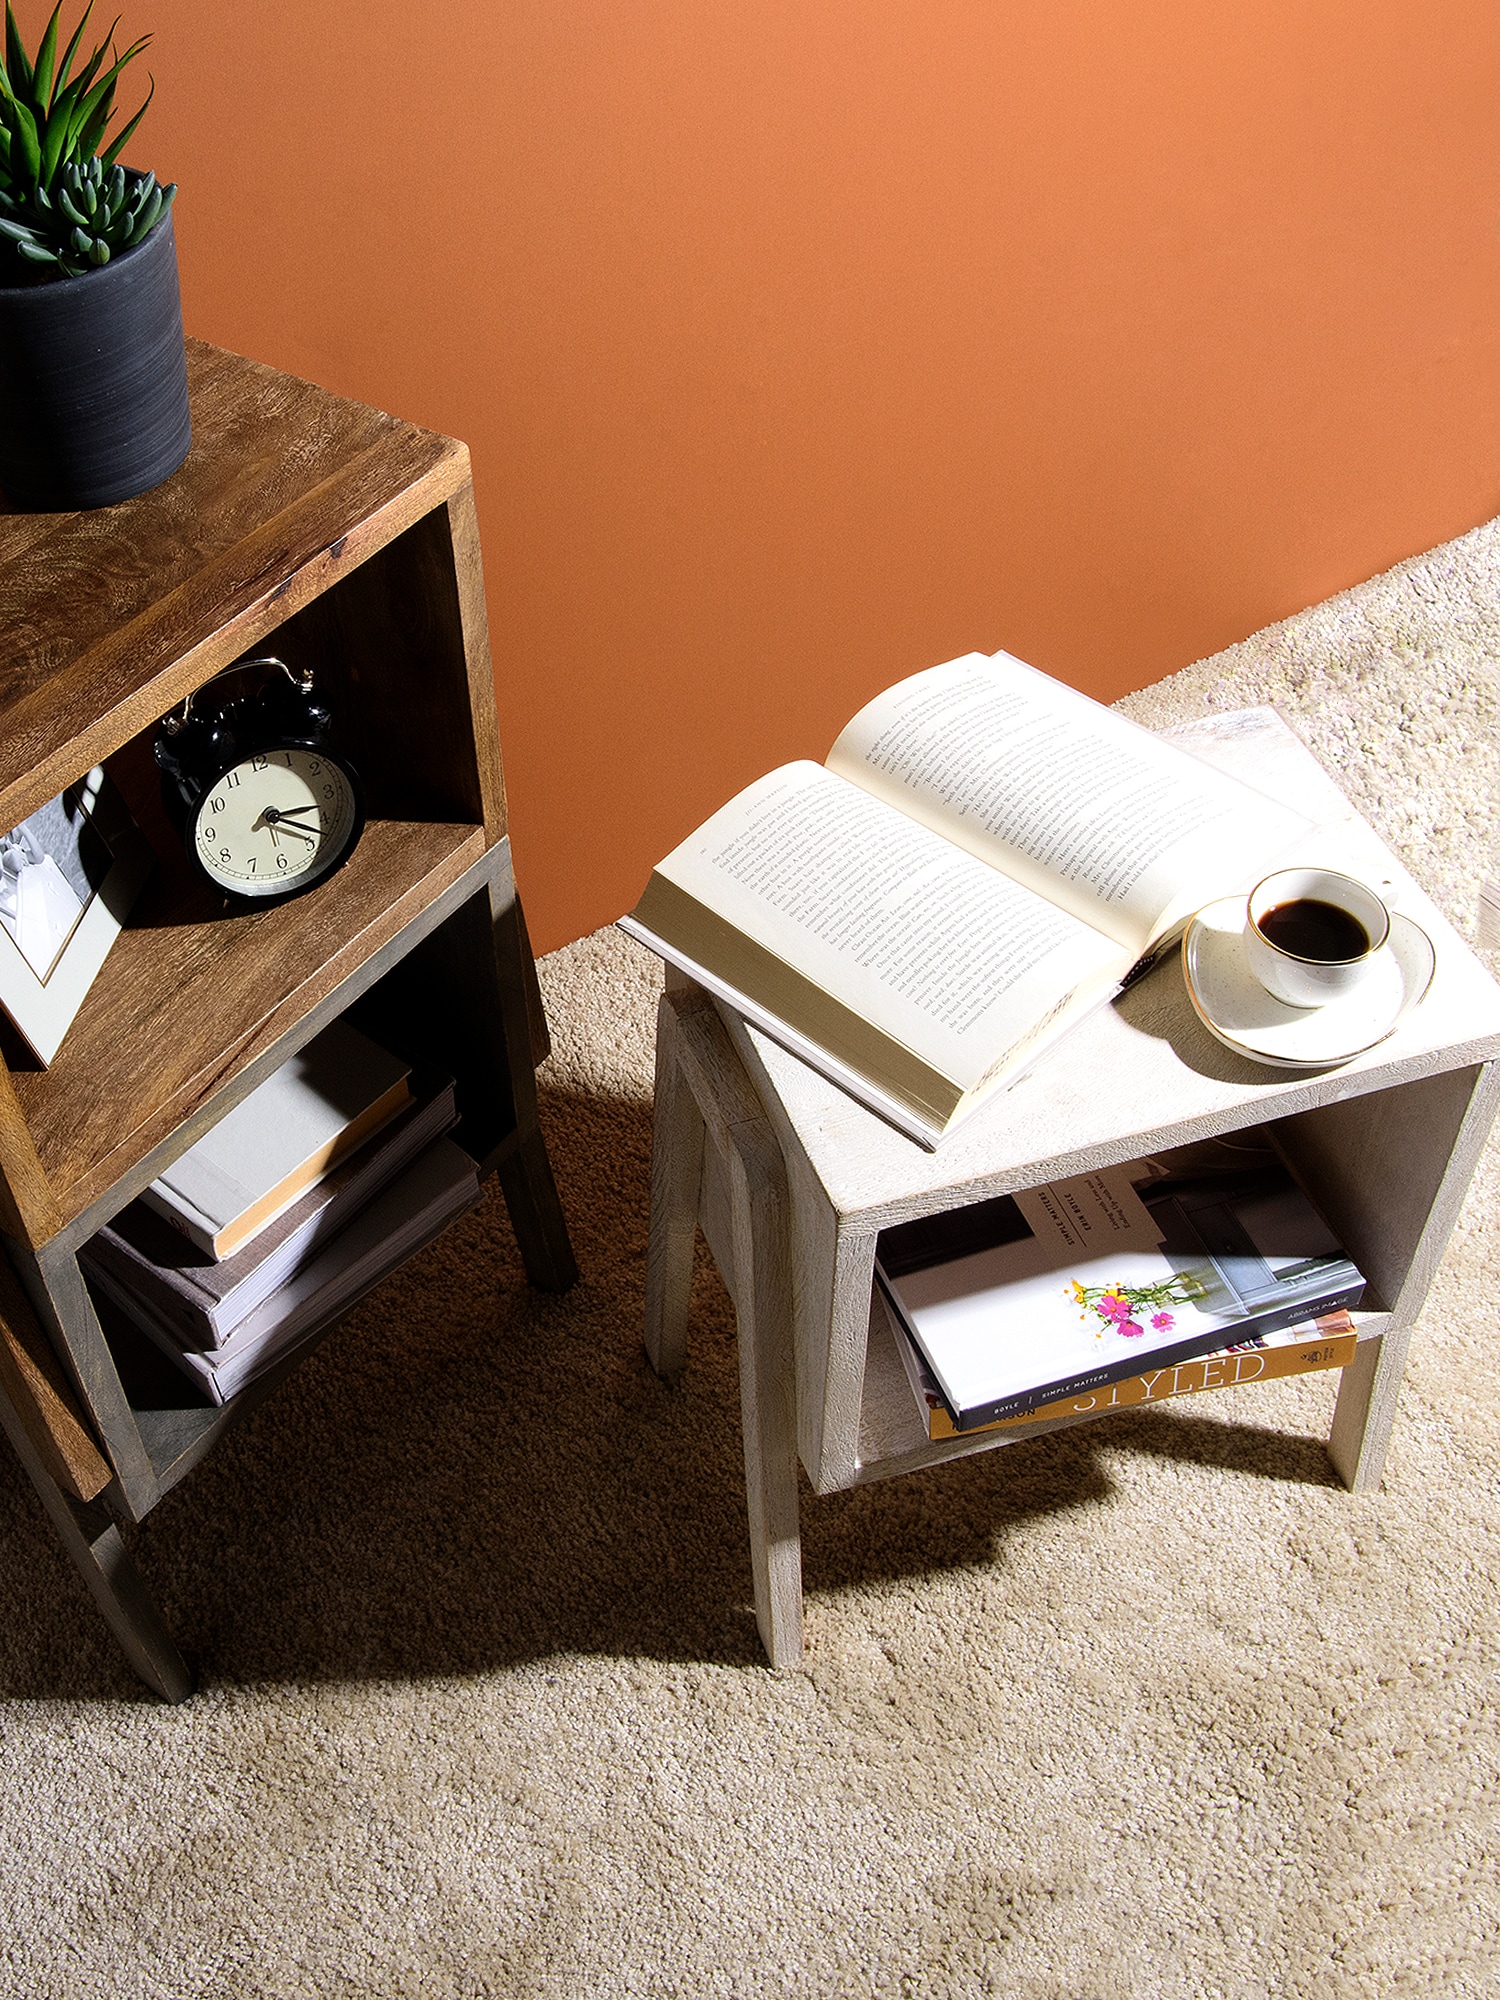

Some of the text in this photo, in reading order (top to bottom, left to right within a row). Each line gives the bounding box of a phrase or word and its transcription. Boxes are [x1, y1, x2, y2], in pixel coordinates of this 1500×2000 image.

[251, 755, 268, 773] 12
[285, 753, 293, 767] 1
[309, 762, 320, 776] 2
[226, 772, 241, 789] 11
[322, 784, 335, 799] 3
[210, 796, 225, 814] 10
[320, 811, 330, 825] 4
[205, 827, 216, 842] 9
[304, 836, 315, 852] 5
[219, 848, 232, 862] 8
[276, 853, 288, 868] 6
[247, 857, 257, 873] 7
[1038, 1191, 1075, 1246] SIMPLE MATTERS
[1064, 1193, 1092, 1231] ERIN BOYLE
[1106, 1212, 1120, 1230] Living
[994, 1373, 1108, 1414] BOYLE SIMPLE MATTERS
